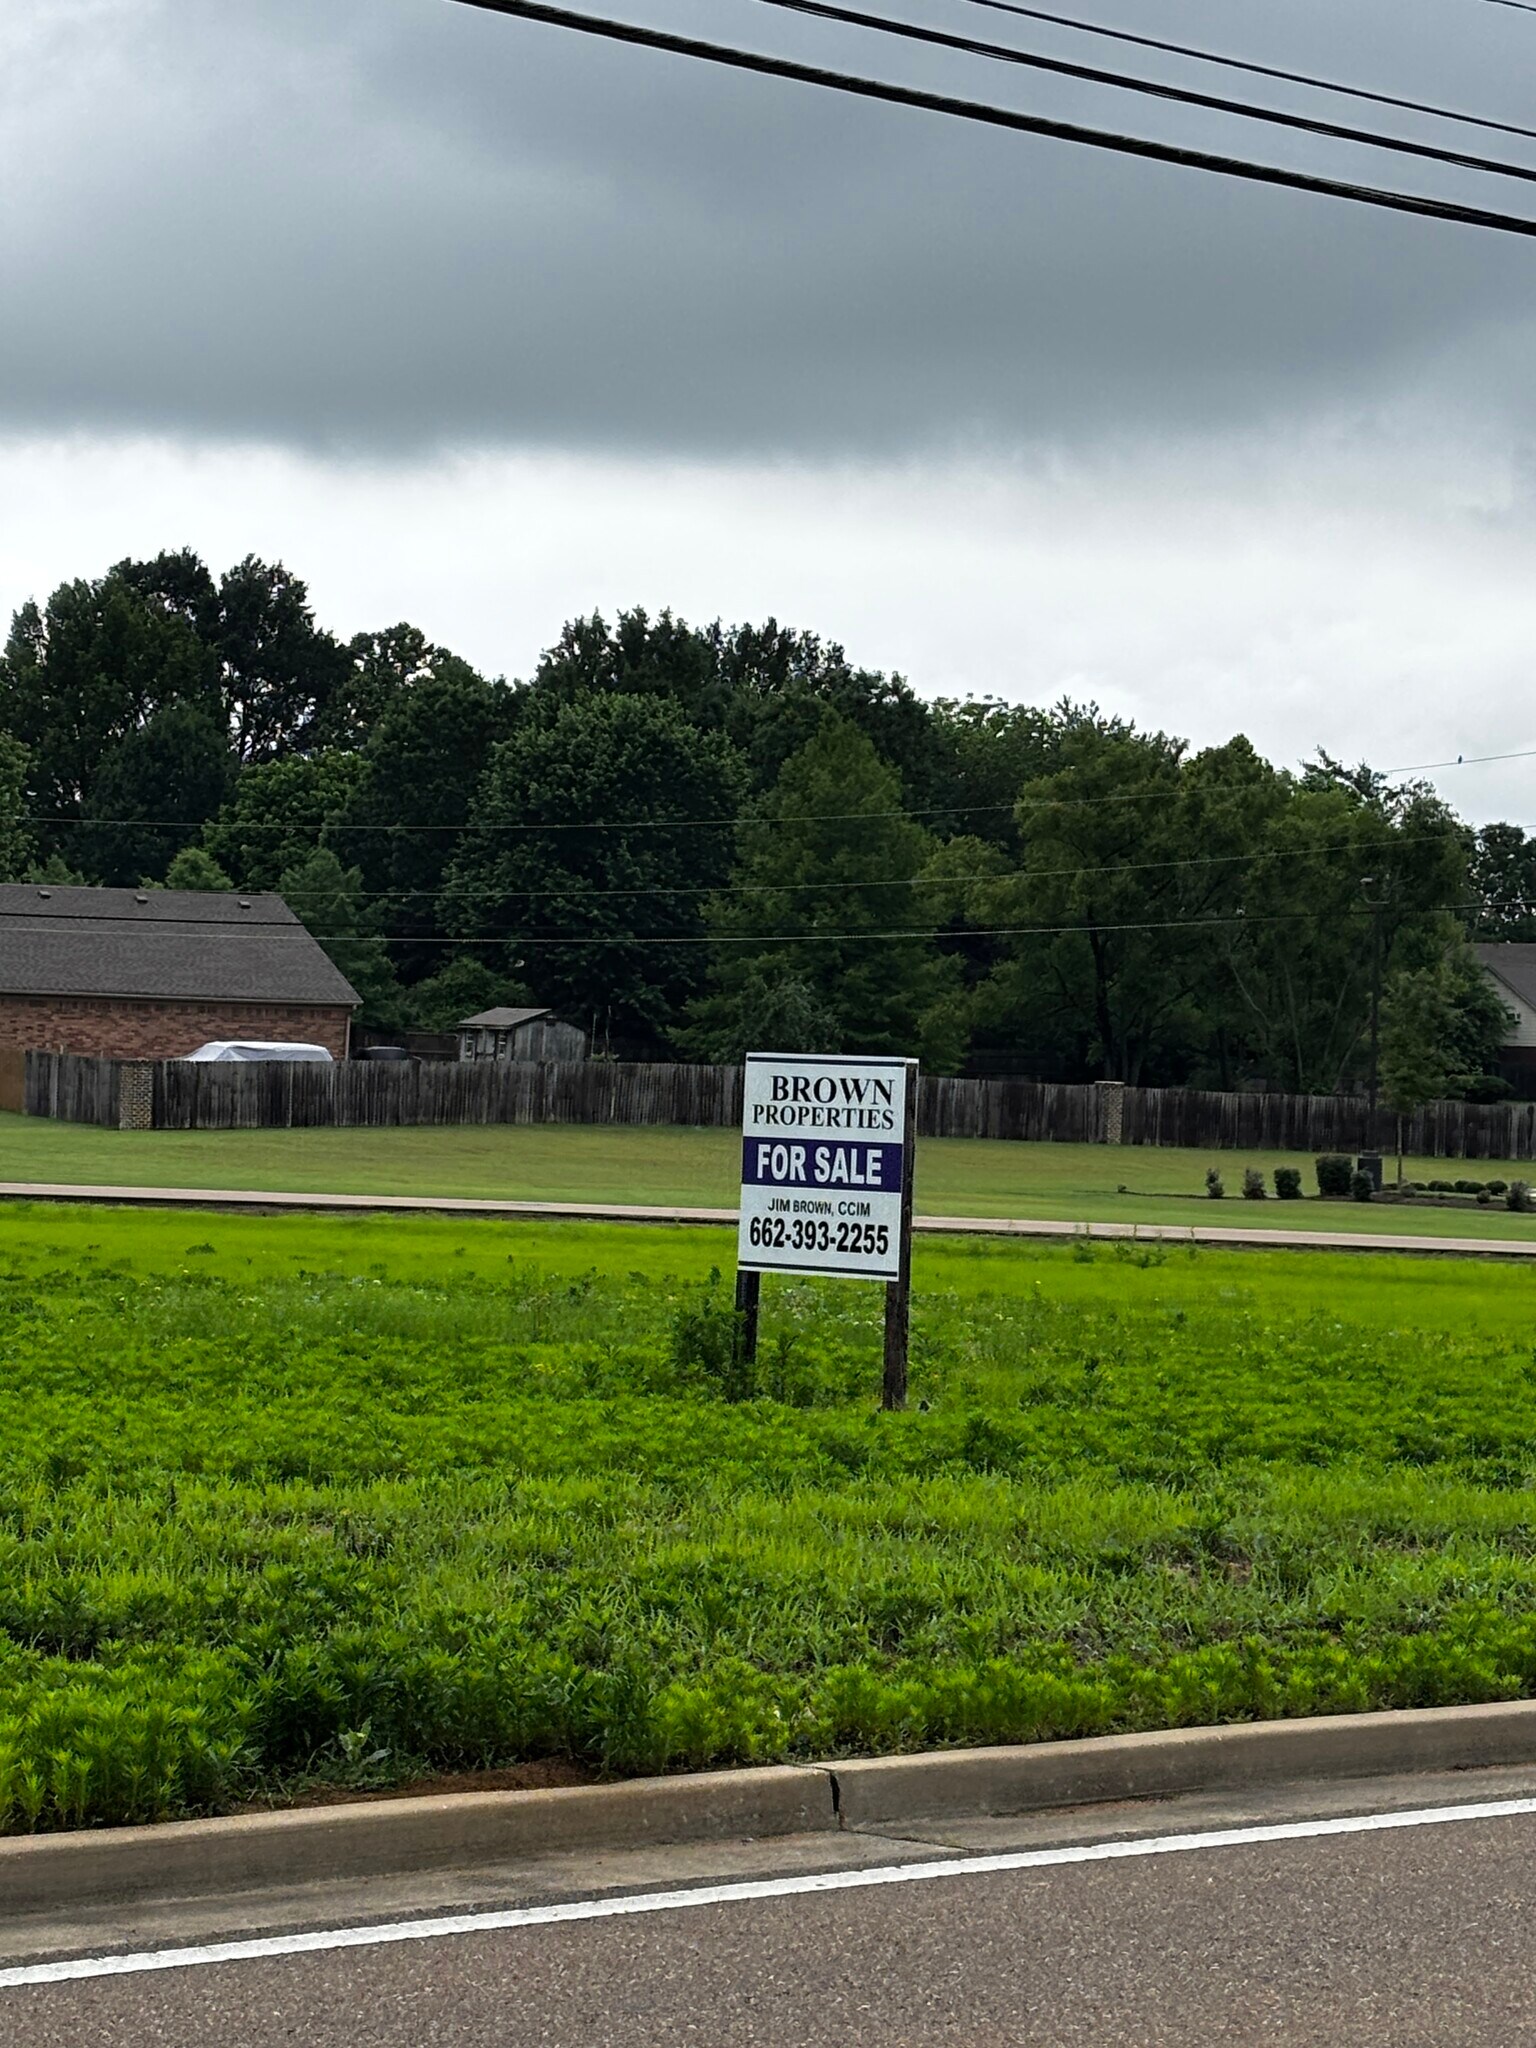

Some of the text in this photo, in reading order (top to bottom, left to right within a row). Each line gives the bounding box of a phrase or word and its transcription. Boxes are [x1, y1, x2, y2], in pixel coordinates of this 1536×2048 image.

[770, 1075, 895, 1106] BROWN
[752, 1104, 895, 1130] PROPERTIES
[756, 1144, 884, 1185] FOR SALE
[767, 1198, 871, 1217] JIM BROWN, CCIM
[749, 1216, 889, 1255] 662-393-2255
